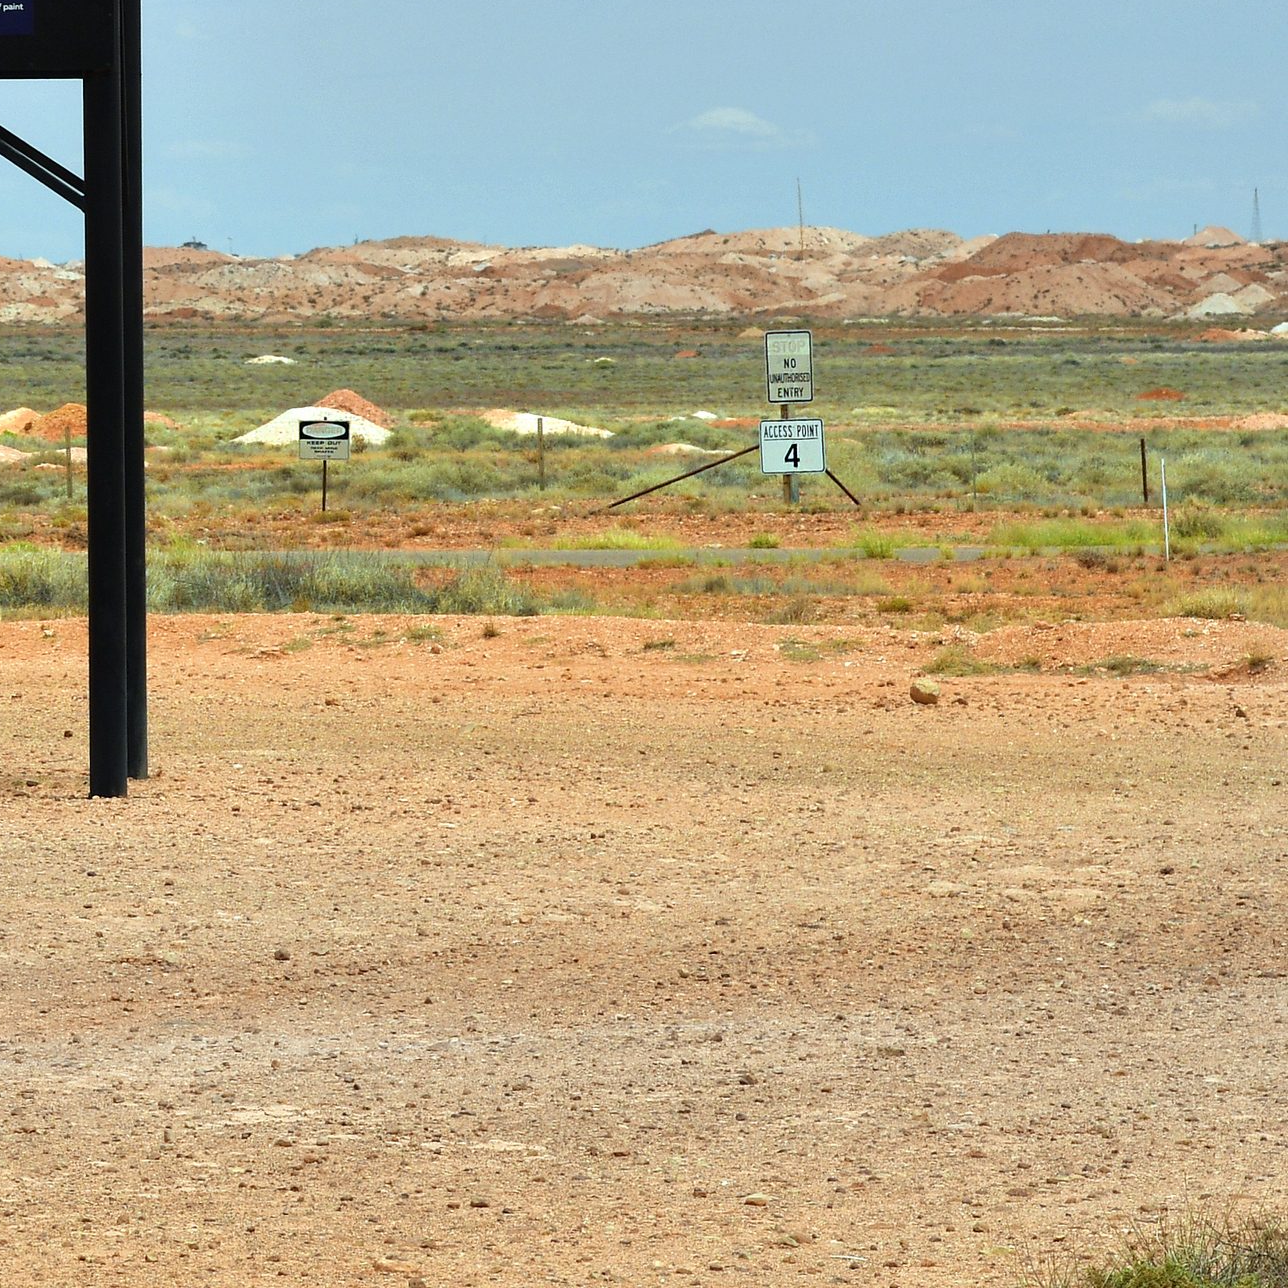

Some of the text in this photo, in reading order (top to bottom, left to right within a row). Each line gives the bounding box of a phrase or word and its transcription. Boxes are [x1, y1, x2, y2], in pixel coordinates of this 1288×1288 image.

[3, 3, 23, 12] paint
[773, 340, 806, 353] STOP
[784, 359, 796, 369] NO
[770, 373, 810, 384] UNAUTHORISED
[778, 388, 804, 398] ENTRY
[764, 424, 819, 438] ACCESS POINT
[784, 443, 800, 468] 4
